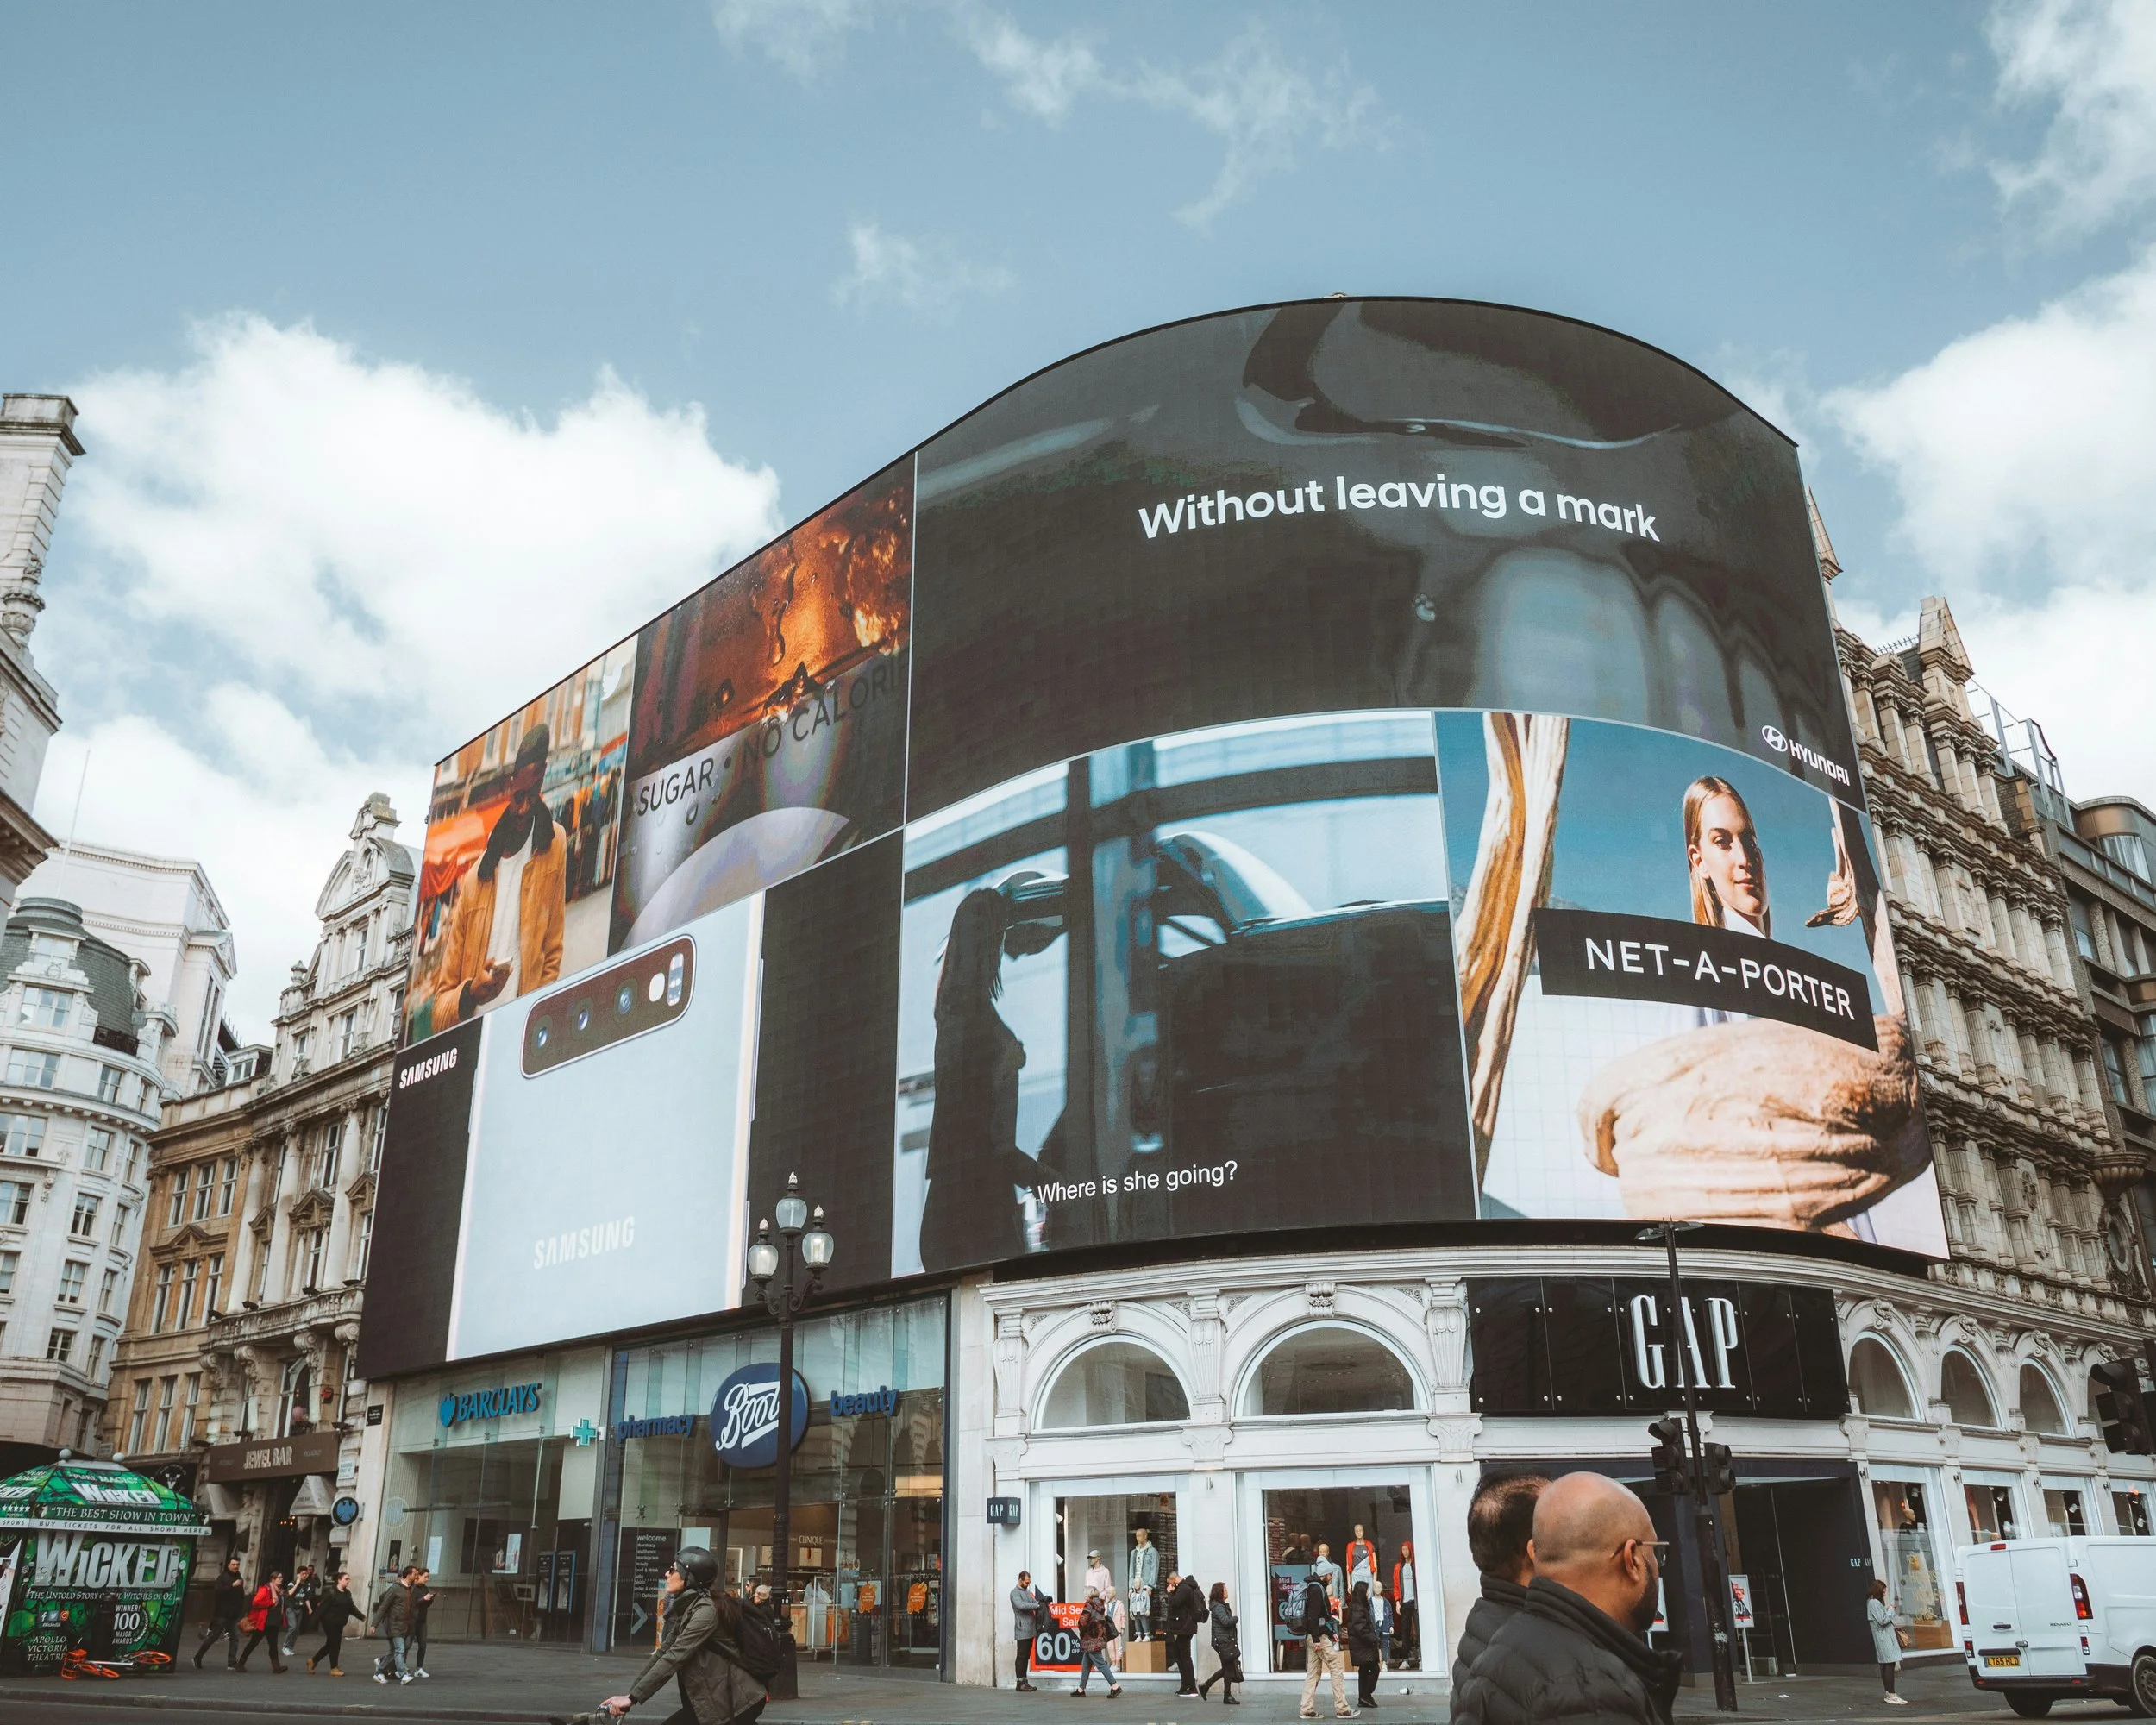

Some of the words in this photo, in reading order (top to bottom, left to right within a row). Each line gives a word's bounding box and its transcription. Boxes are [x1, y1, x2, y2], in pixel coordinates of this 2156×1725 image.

[1138, 480, 1326, 539] Without
[1336, 474, 1507, 519] leaving
[1519, 488, 1547, 517] a
[1556, 493, 1661, 543] mark
[637, 757, 715, 817] SUGAR
[743, 717, 782, 762] NO
[1789, 739, 1851, 787] HYUNDAI
[1584, 938, 1856, 1021] NET-A-PORTER
[399, 1047, 459, 1090] SAMSUNG
[1037, 1182, 1096, 1204] Where
[1102, 1175, 1118, 1195] is
[1123, 1170, 1160, 1192] she
[1165, 1159, 1238, 1192] going?
[533, 1216, 636, 1270] SAMSUNG
[1630, 1294, 1739, 1389] GAP
[456, 1383, 542, 1422] BARCLAYS
[830, 1385, 900, 1417] beauty
[715, 1381, 780, 1451] Boot
[617, 1414, 696, 1443] pharmacy
[243, 1449, 272, 1470] JEWEL
[273, 1446, 293, 1465] BAR
[79, 1509, 108, 1520] BEST
[109, 1510, 141, 1521] SHOW
[143, 1511, 156, 1521] IN
[990, 1504, 1004, 1517] GAP
[1008, 1505, 1019, 1517] GAP
[64, 1521, 98, 1530] TICKETS
[799, 1535, 824, 1546] CLINIQUE
[1850, 1558, 1861, 1567] GAP
[30, 1590, 44, 1600] THE
[1050, 1606, 1067, 1615] Mid
[1733, 1600, 1743, 1615] 60
[113, 1612, 141, 1630] 100
[28, 1644, 68, 1653] VICTORIA
[33, 1635, 66, 1644] APOLLO
[1037, 1631, 1071, 1661] 60
[1987, 1657, 2005, 1666] LT65
[2005, 1657, 2019, 1666] HLD
